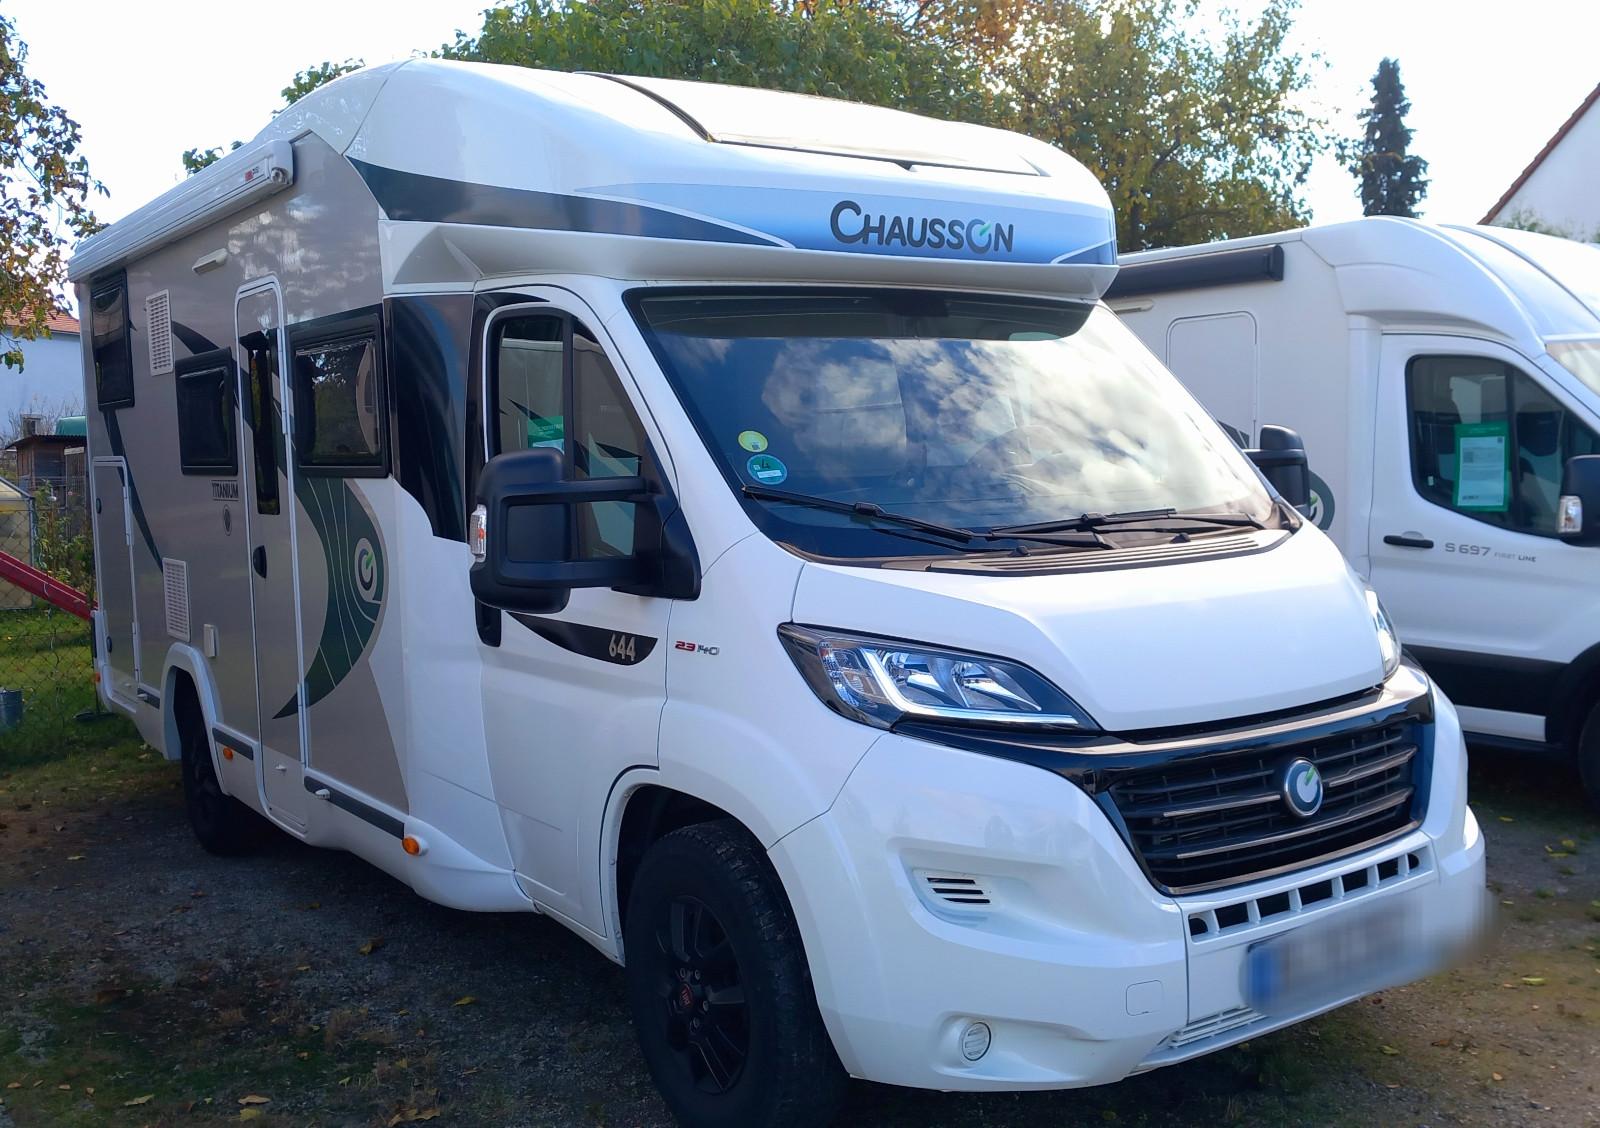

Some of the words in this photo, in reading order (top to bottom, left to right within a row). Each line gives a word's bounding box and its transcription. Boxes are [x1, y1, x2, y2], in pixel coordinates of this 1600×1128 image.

[830, 200, 1014, 254] CHAUSSON
[211, 482, 239, 499] TITANIUM
[1444, 542, 1456, 553] S
[1458, 544, 1491, 556] 697
[1518, 554, 1536, 563] LINE
[608, 633, 637, 661] 644
[674, 640, 696, 652] 23
